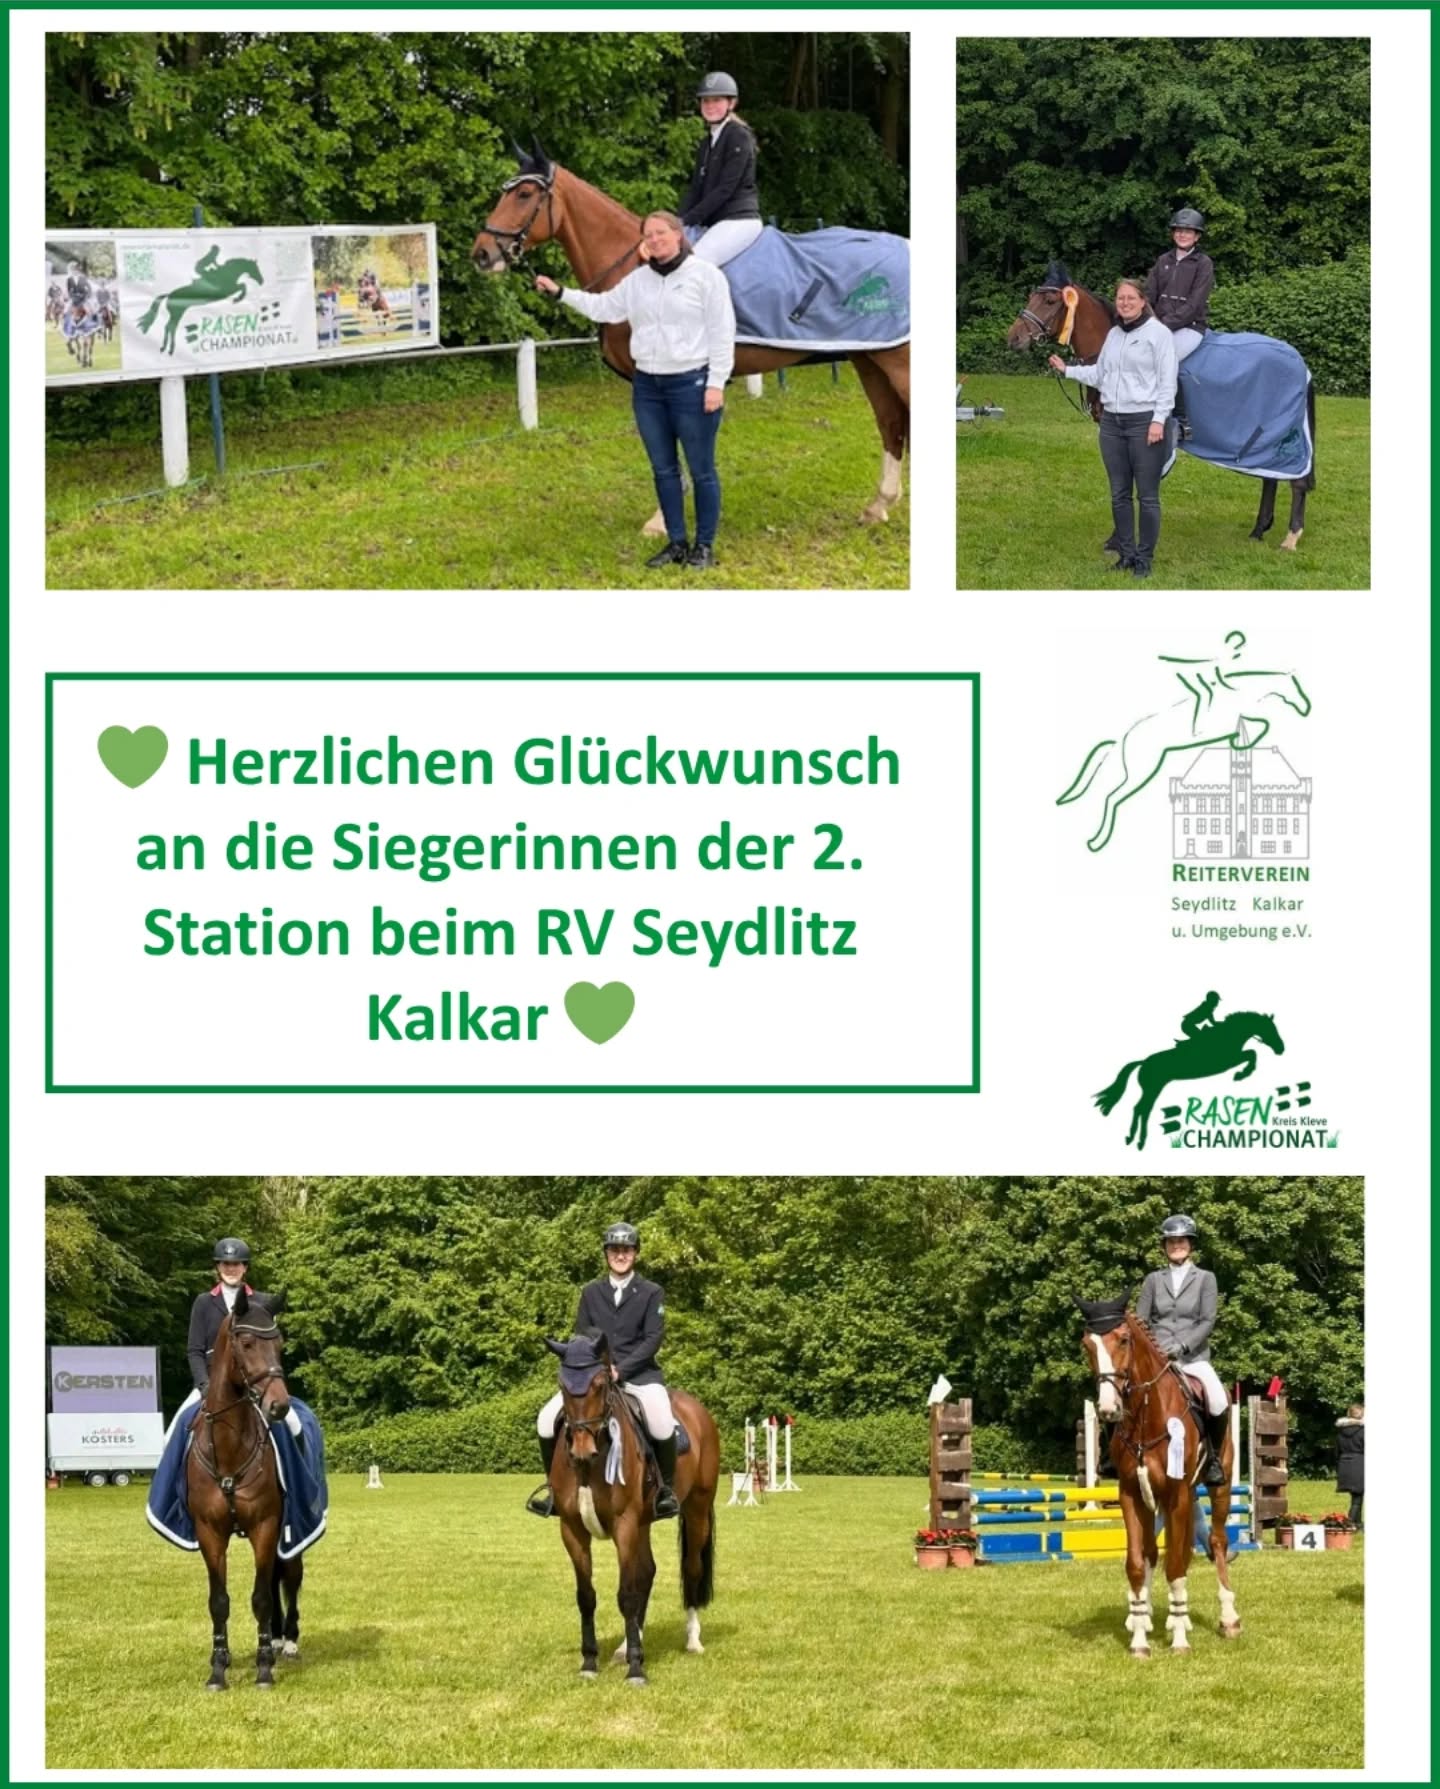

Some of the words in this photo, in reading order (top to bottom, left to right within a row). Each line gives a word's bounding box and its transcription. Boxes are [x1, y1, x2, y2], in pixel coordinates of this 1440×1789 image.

[201, 312, 259, 336] RASEN
[200, 331, 293, 352] CHAMPIONAT
[54, 1371, 154, 1393] KERSTEN
[1301, 1531, 1317, 1549] 4
